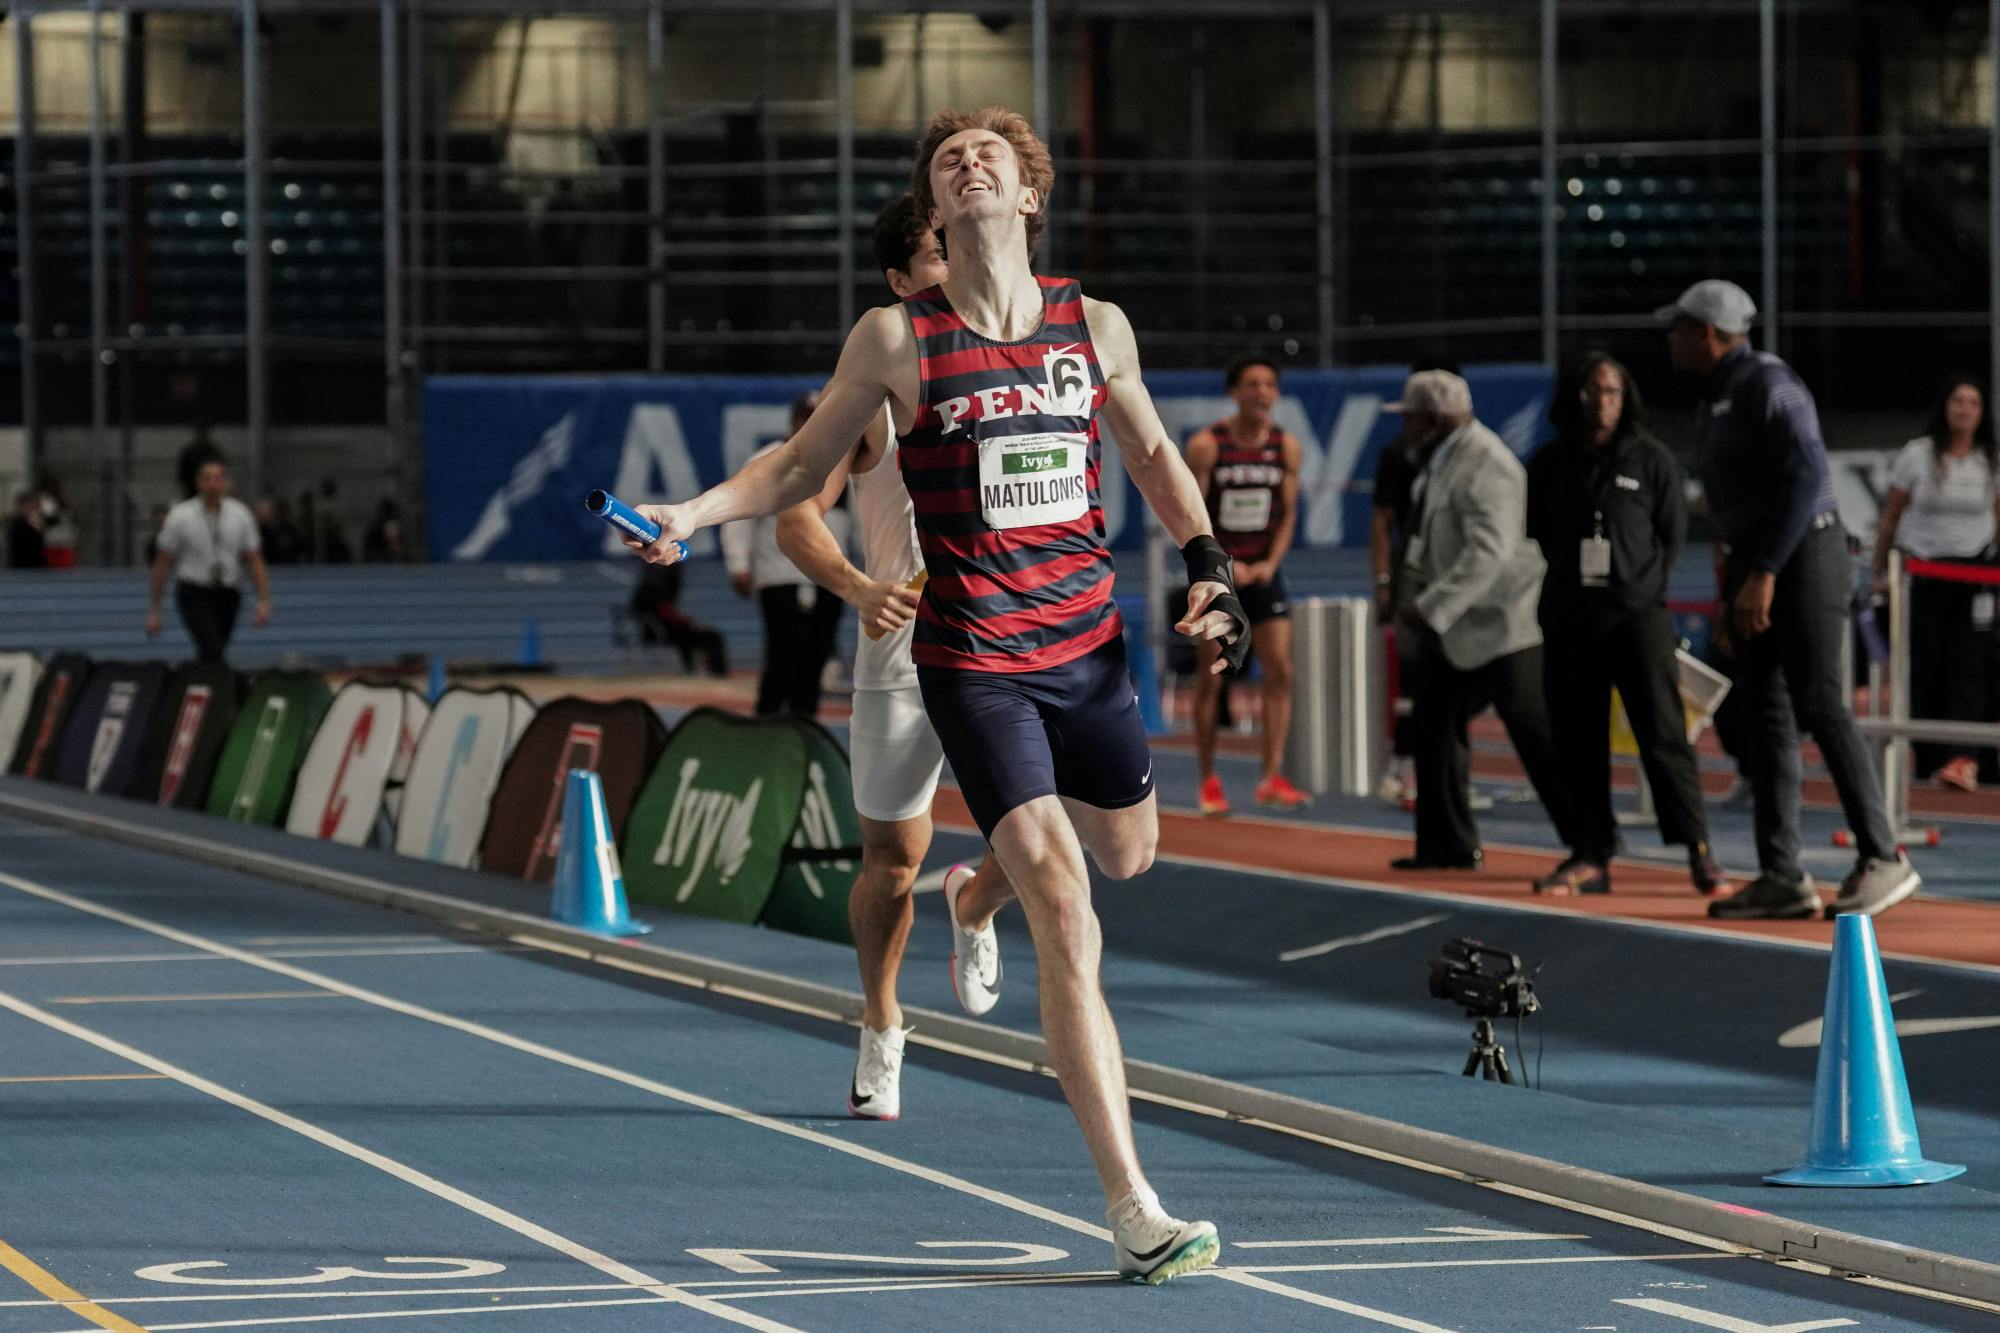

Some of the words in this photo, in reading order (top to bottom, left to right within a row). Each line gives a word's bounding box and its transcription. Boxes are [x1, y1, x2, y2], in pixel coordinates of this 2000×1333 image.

[1052, 357, 1084, 400] 6
[932, 383, 1098, 436] PEN
[984, 475, 1084, 510] MATULONIS
[134, 1256, 507, 1286] 3
[684, 1241, 1070, 1274] 2
